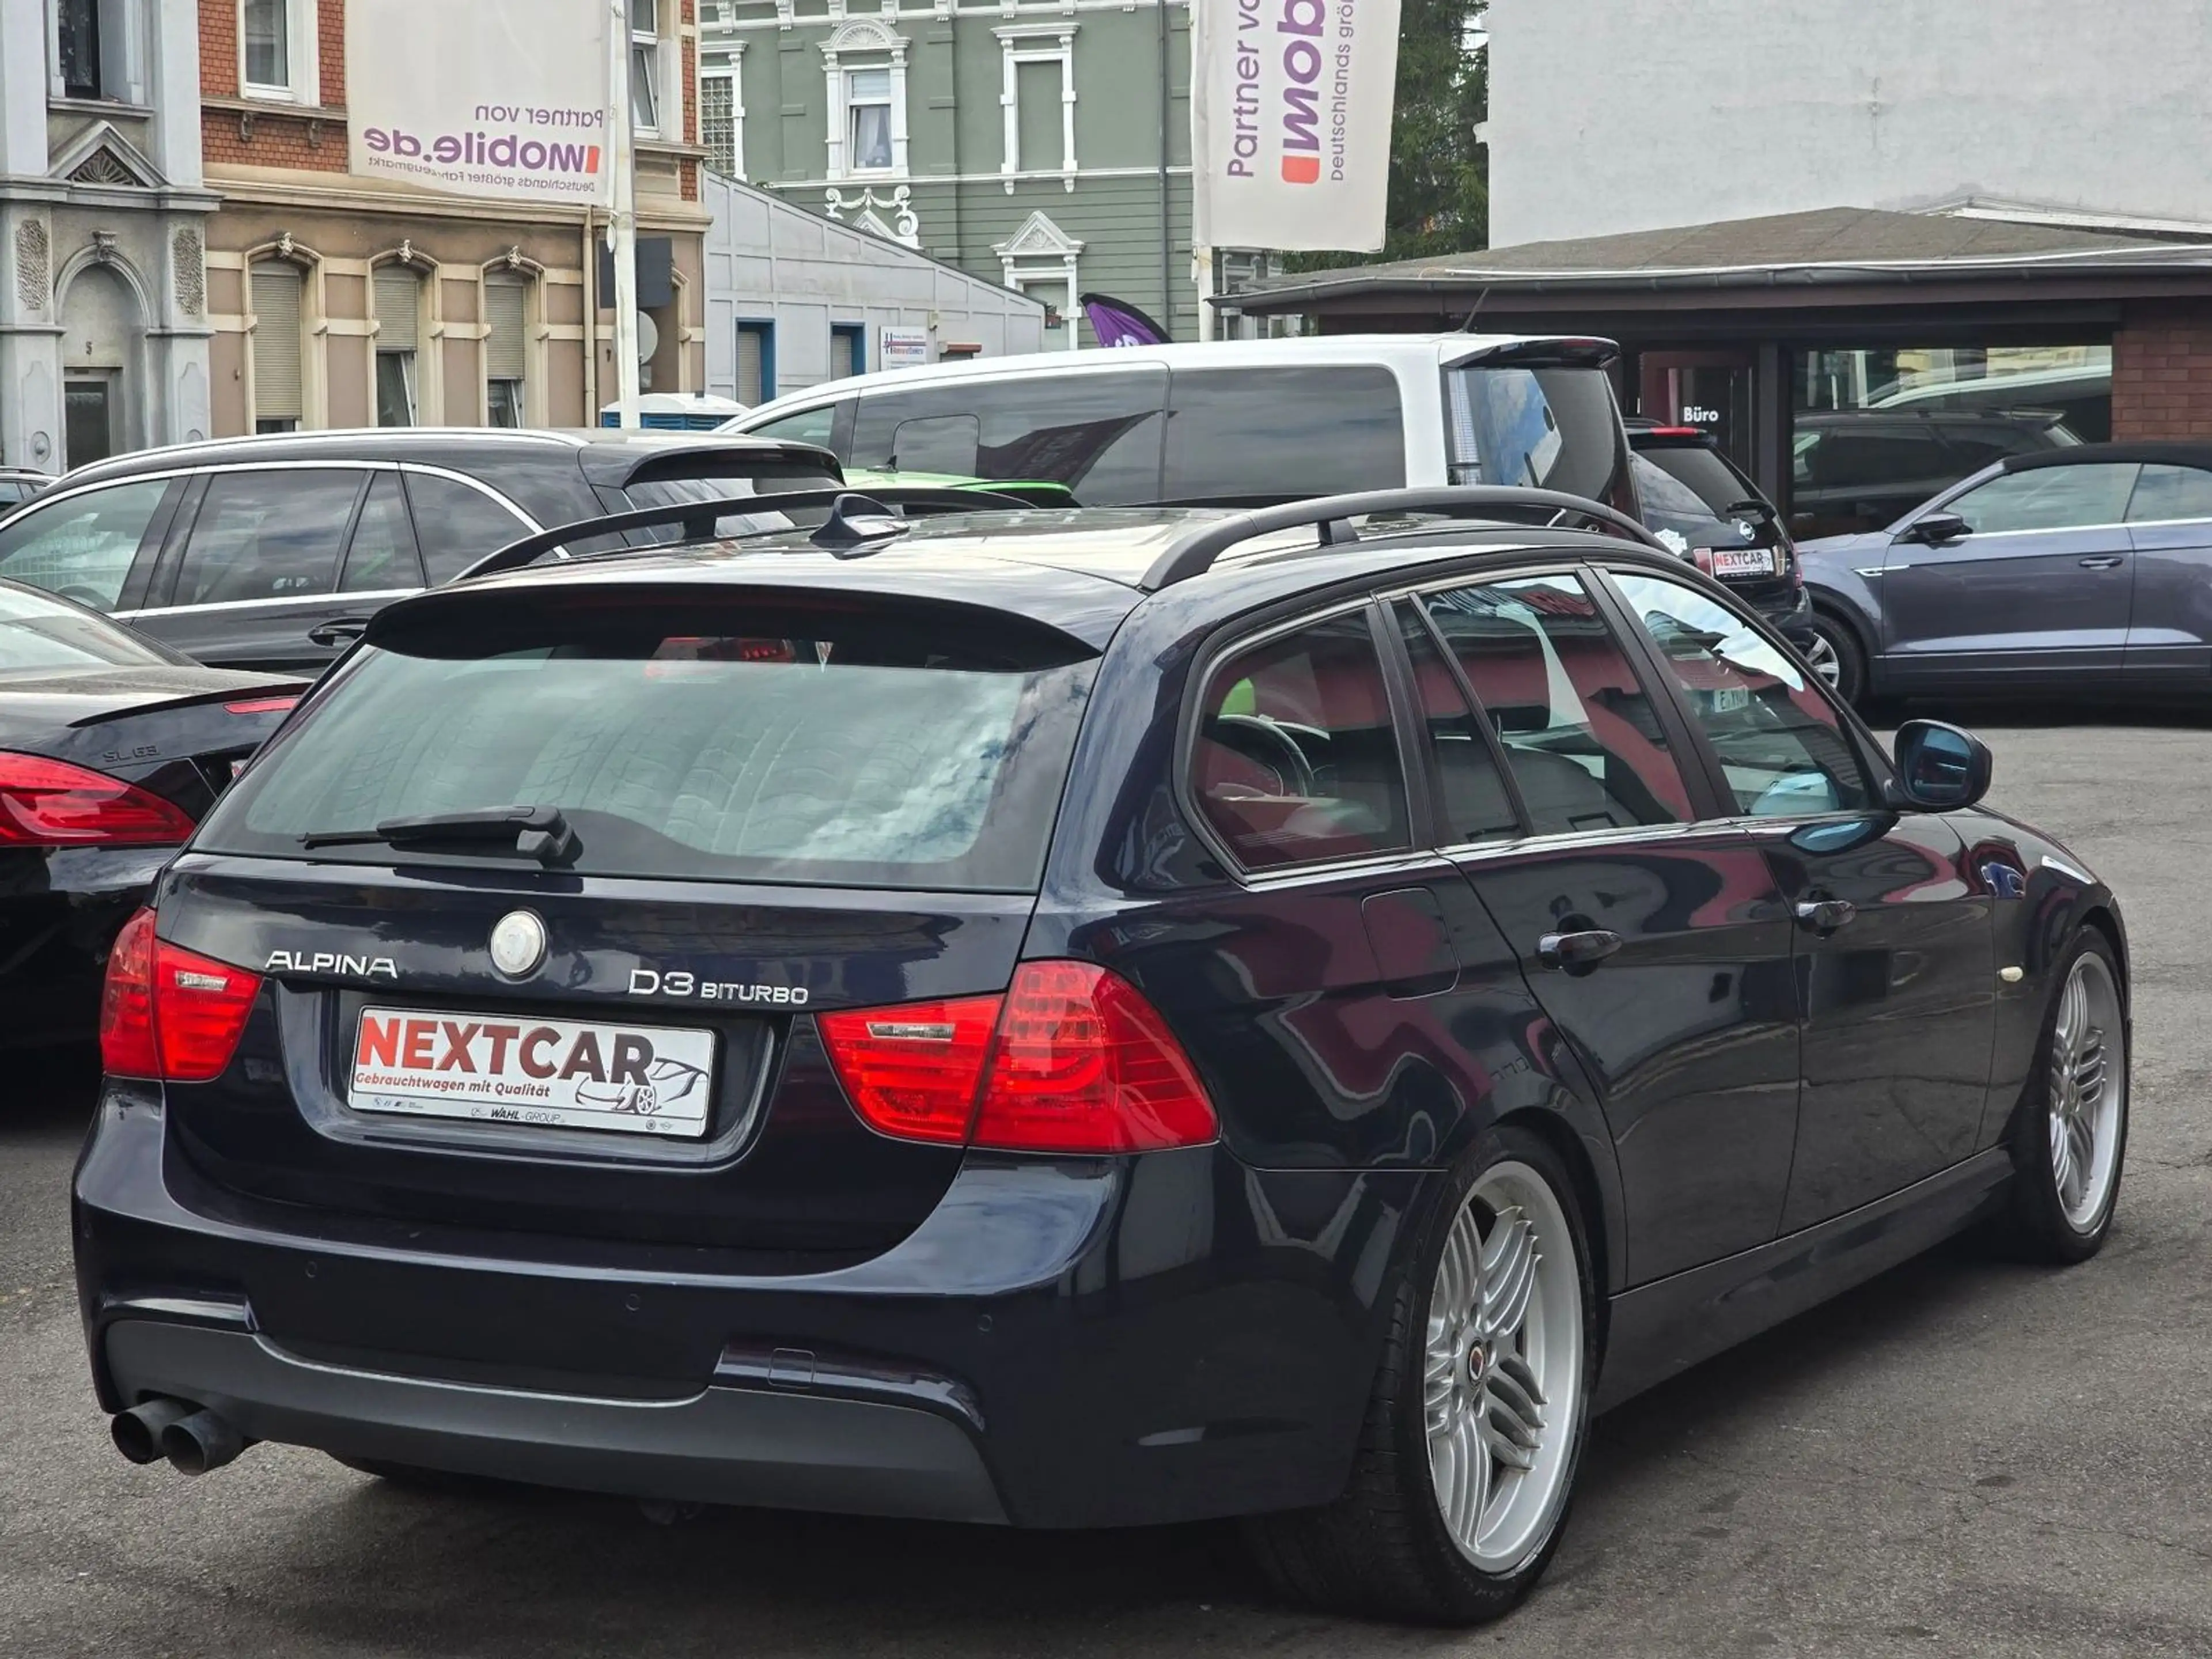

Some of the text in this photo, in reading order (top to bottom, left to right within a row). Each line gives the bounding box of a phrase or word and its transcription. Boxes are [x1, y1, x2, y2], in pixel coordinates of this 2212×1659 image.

[1331, 0, 1354, 181] Deutschlands grö
[1228, 40, 1259, 177] Partner
[1683, 406, 1719, 422] Büro
[1715, 551, 1763, 567] NEXTCAR
[264, 950, 397, 979] ALPINA
[628, 969, 809, 1005] D3 BITURBO
[357, 1016, 655, 1087] NEXTCAR
[355, 1072, 551, 1097] Gebrauchtwagen mit Qualität
